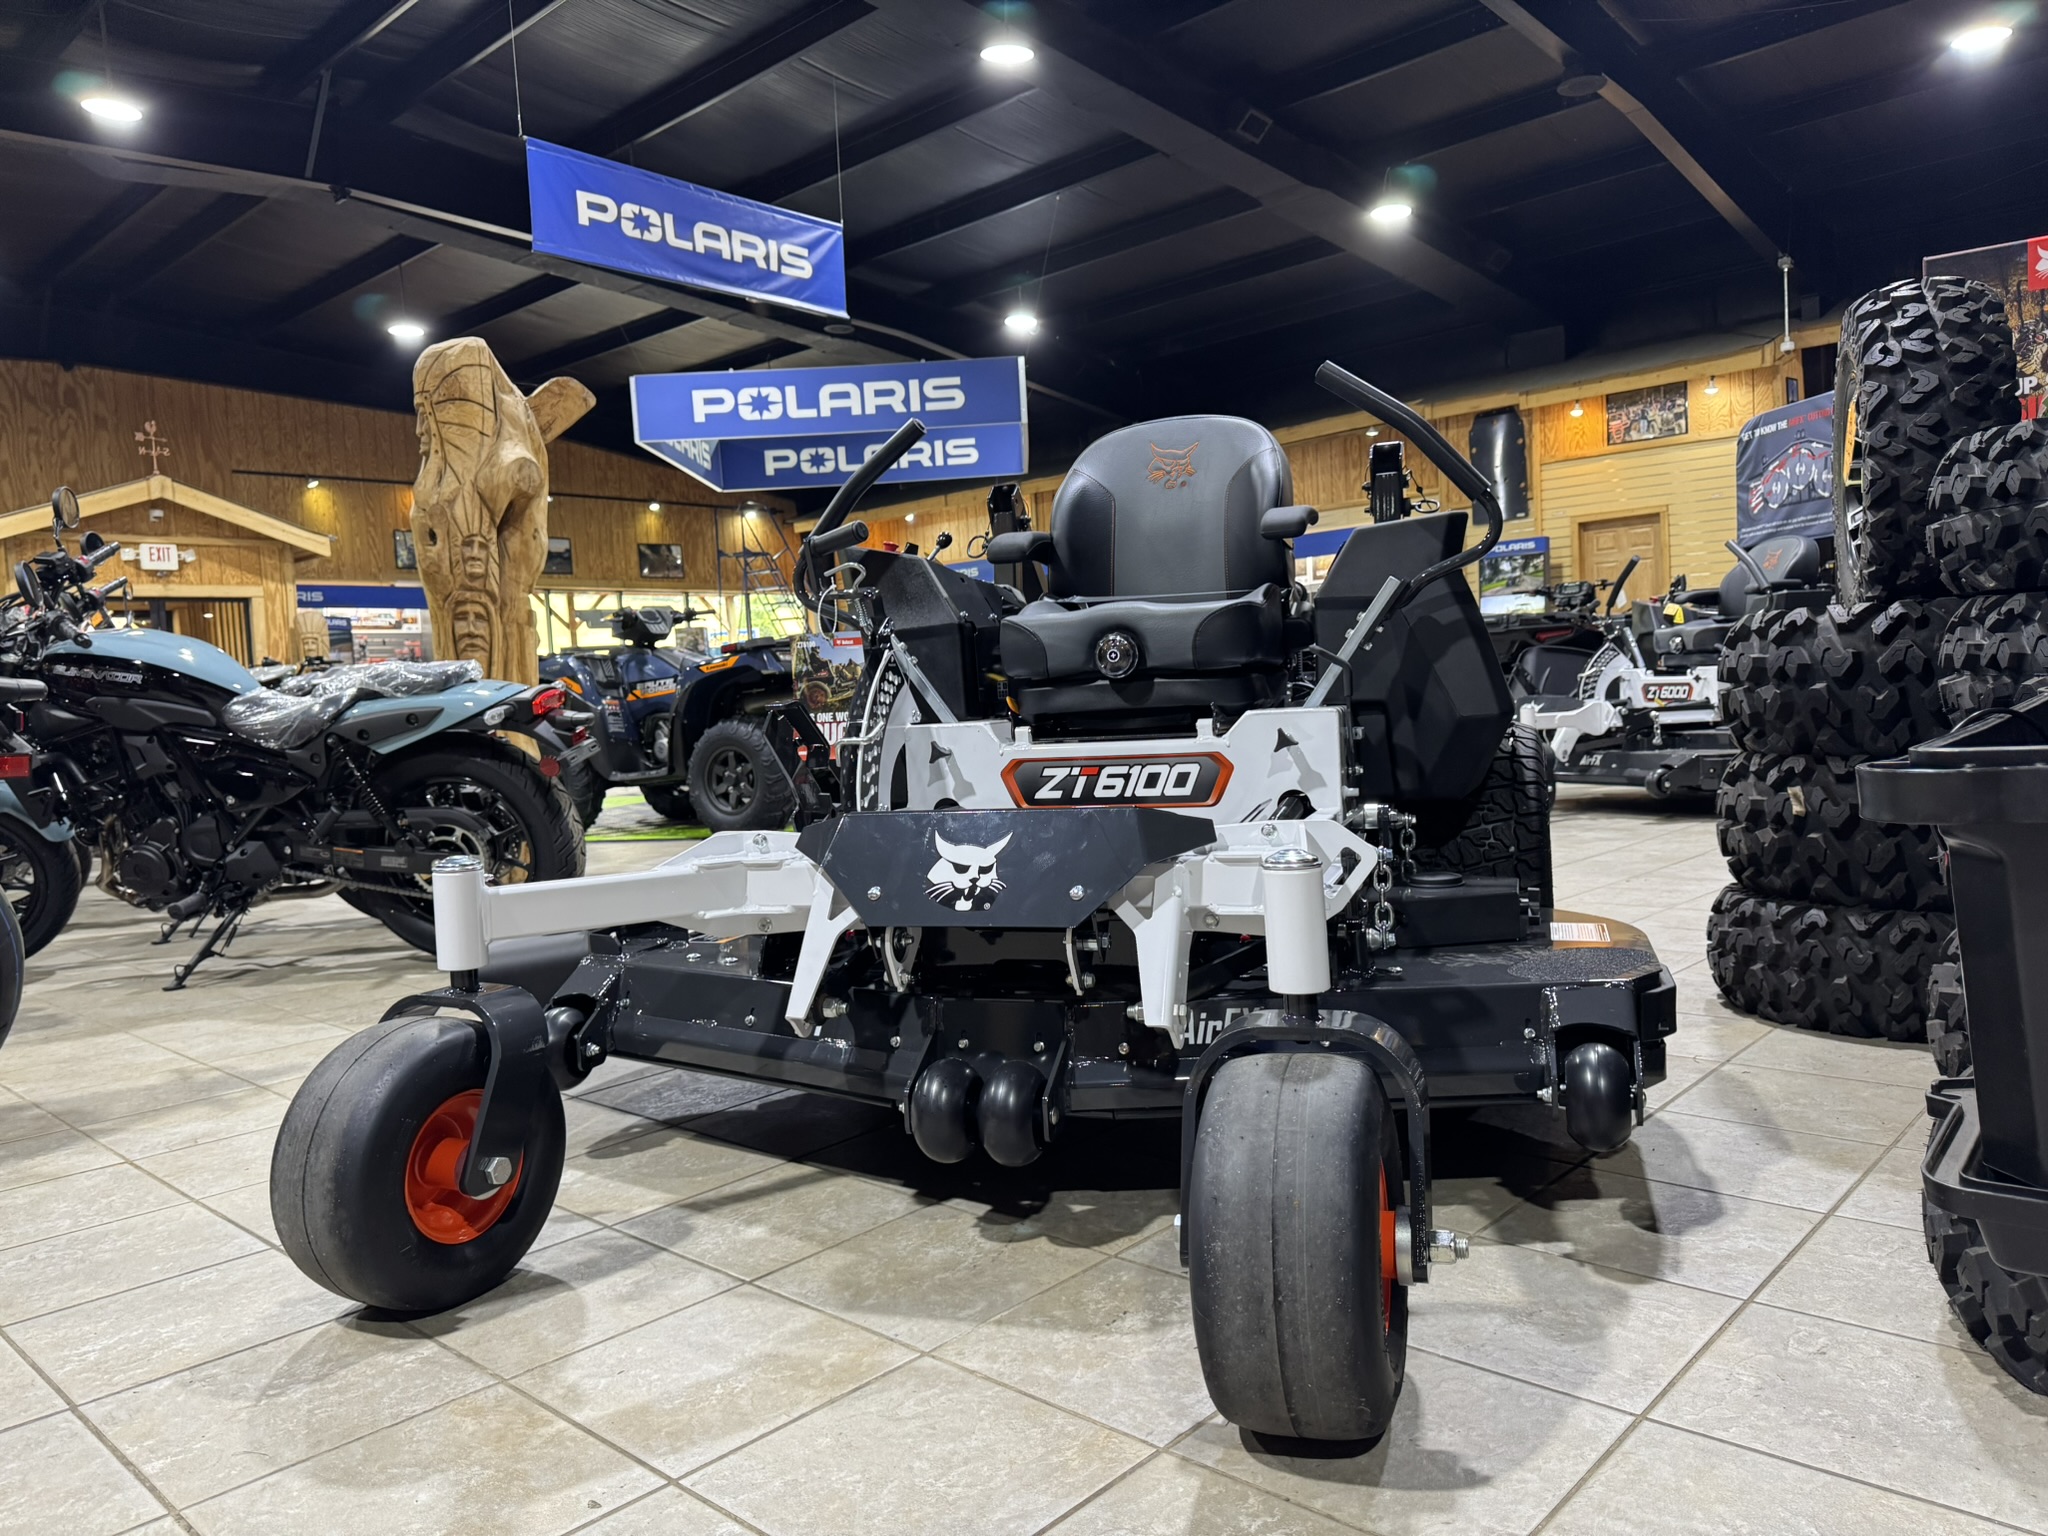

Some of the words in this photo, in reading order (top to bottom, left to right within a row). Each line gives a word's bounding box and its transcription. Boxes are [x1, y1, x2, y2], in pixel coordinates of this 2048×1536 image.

[576, 189, 813, 279] POLARIS
[691, 376, 966, 423] POLARIS
[1760, 422, 1777, 435] KNOW
[1777, 419, 1788, 430] THE
[149, 546, 171, 562] EXIT
[1492, 541, 1536, 553] OLARIS
[816, 712, 834, 722] ONE
[1034, 763, 1201, 799] ZT6100
